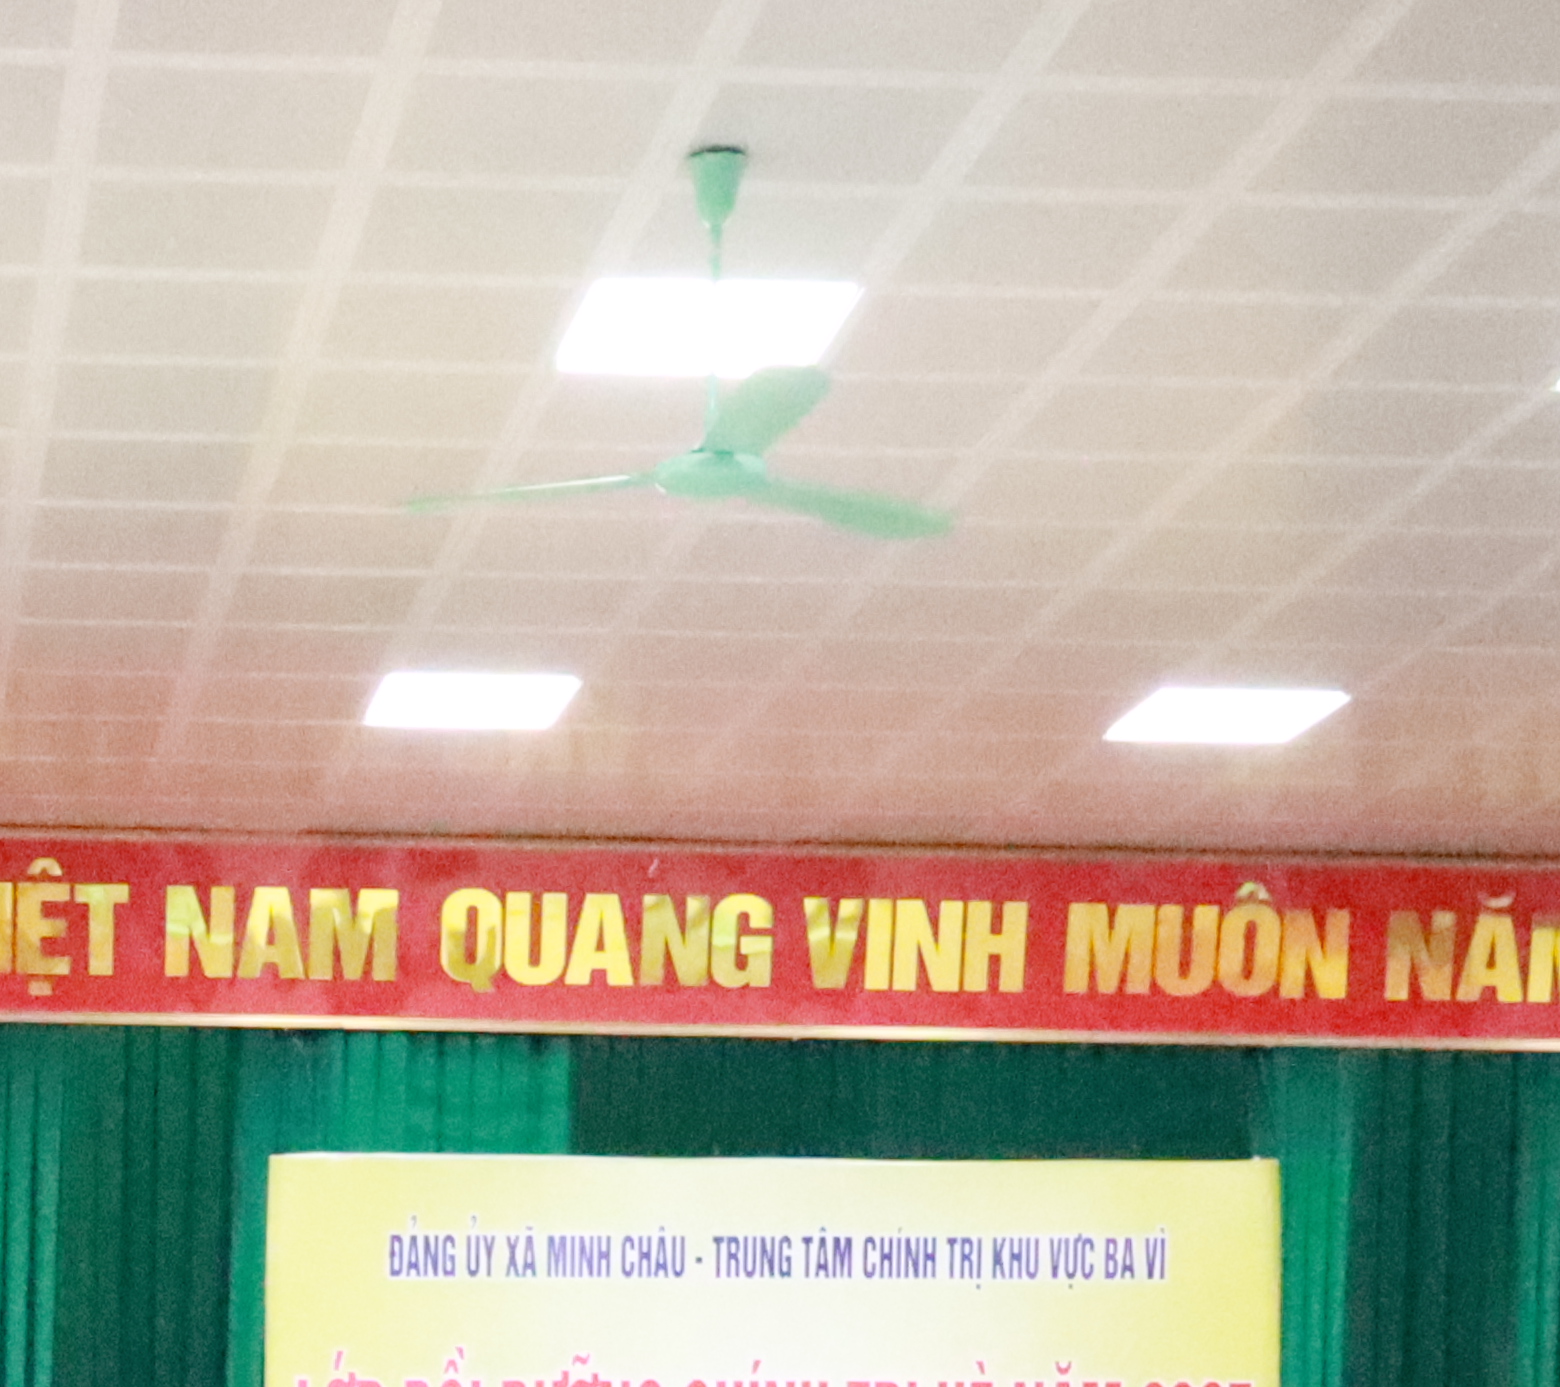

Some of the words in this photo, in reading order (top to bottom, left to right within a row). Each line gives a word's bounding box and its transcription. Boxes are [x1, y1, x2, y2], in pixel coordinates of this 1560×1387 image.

[164, 884, 398, 984] NAM
[440, 889, 774, 992] QUANG
[805, 898, 1028, 993] VINH
[1065, 881, 1351, 999] MUÔN
[389, 1216, 456, 1277] ĐẢNG
[467, 1216, 496, 1278] ỦY
[506, 1226, 536, 1278] XÃ
[547, 1235, 611, 1278] MINH
[622, 1226, 685, 1278] CHÂU
[713, 1235, 792, 1278] TRUNG
[802, 1226, 852, 1279] TÂM
[863, 1227, 936, 1279] CHÍNH
[947, 1237, 982, 1289] TRỊ
[992, 1237, 1039, 1279] KHU
[1050, 1234, 1094, 1289] VỰC
[1105, 1238, 1135, 1279] BA
[1145, 1228, 1166, 1280] VÌ
